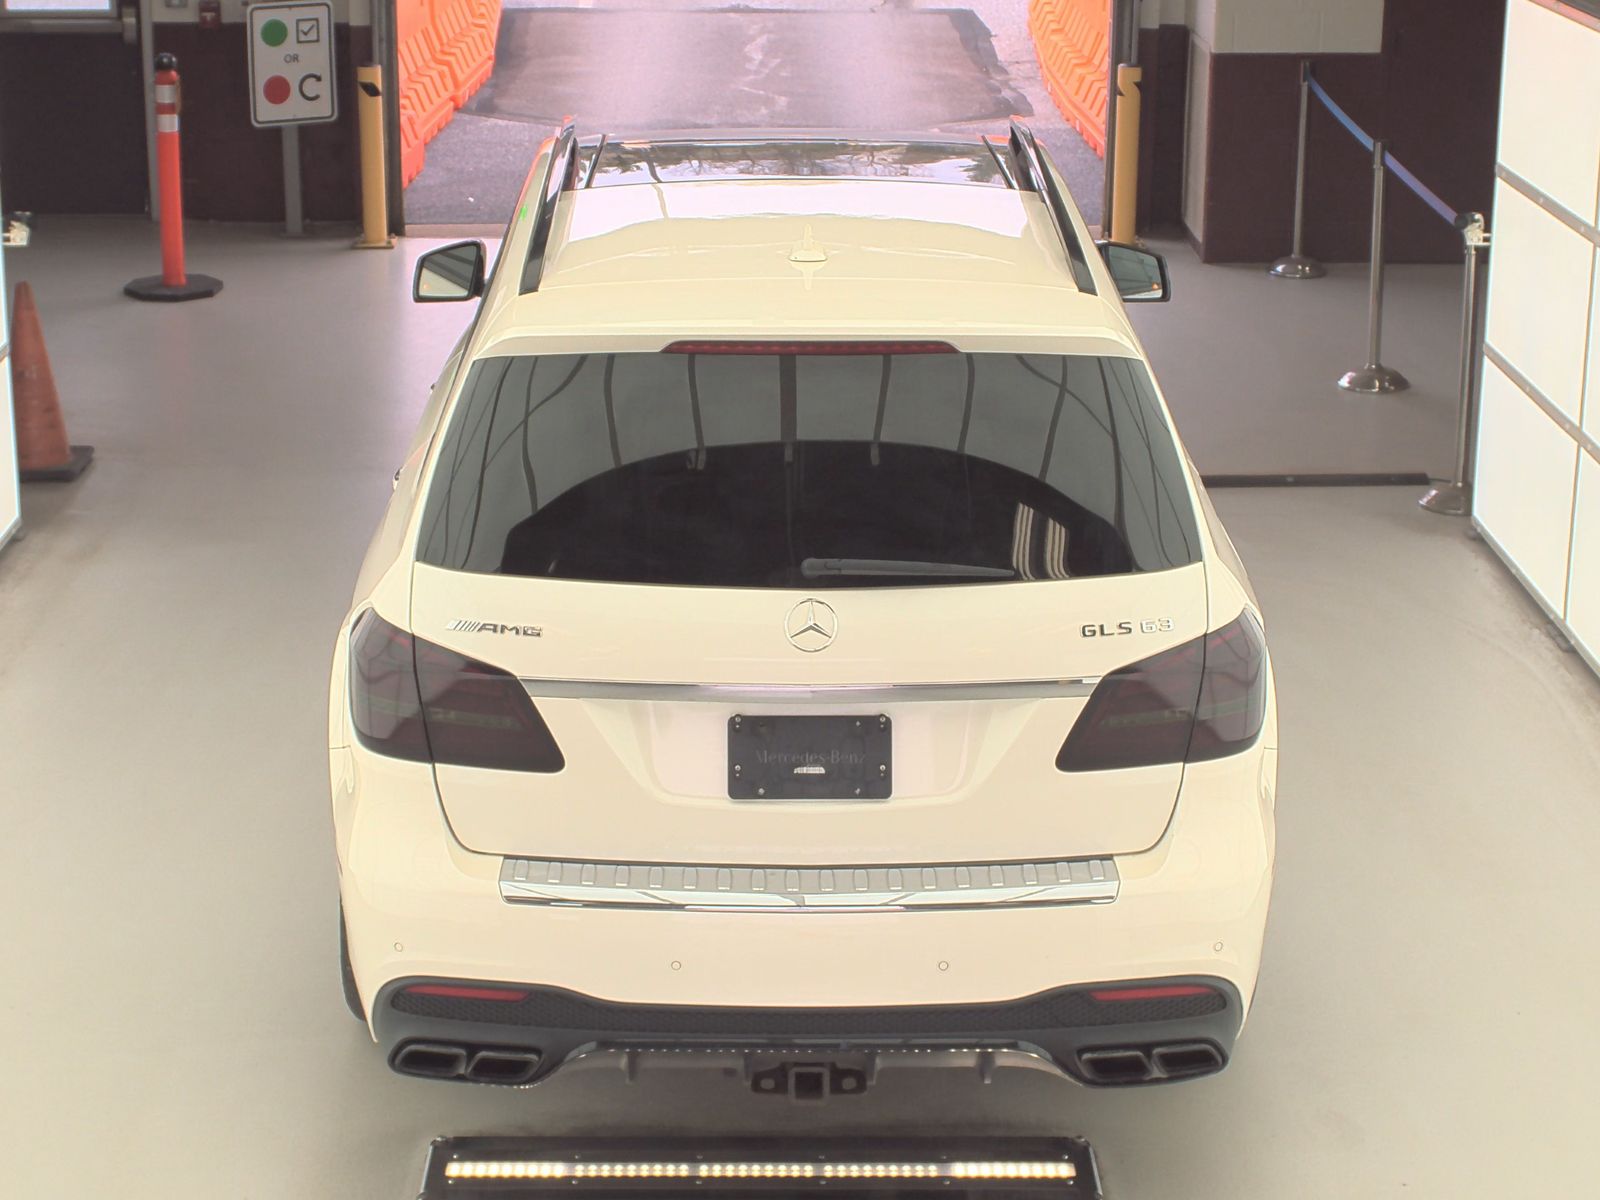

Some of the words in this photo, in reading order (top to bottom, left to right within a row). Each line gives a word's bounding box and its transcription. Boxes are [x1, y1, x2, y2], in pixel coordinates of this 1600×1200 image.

[283, 53, 299, 64] OR
[477, 622, 542, 637] AMG
[1081, 621, 1133, 638] GLS
[1140, 618, 1174, 634] 63
[755, 749, 865, 764] Mercedes-Benz
